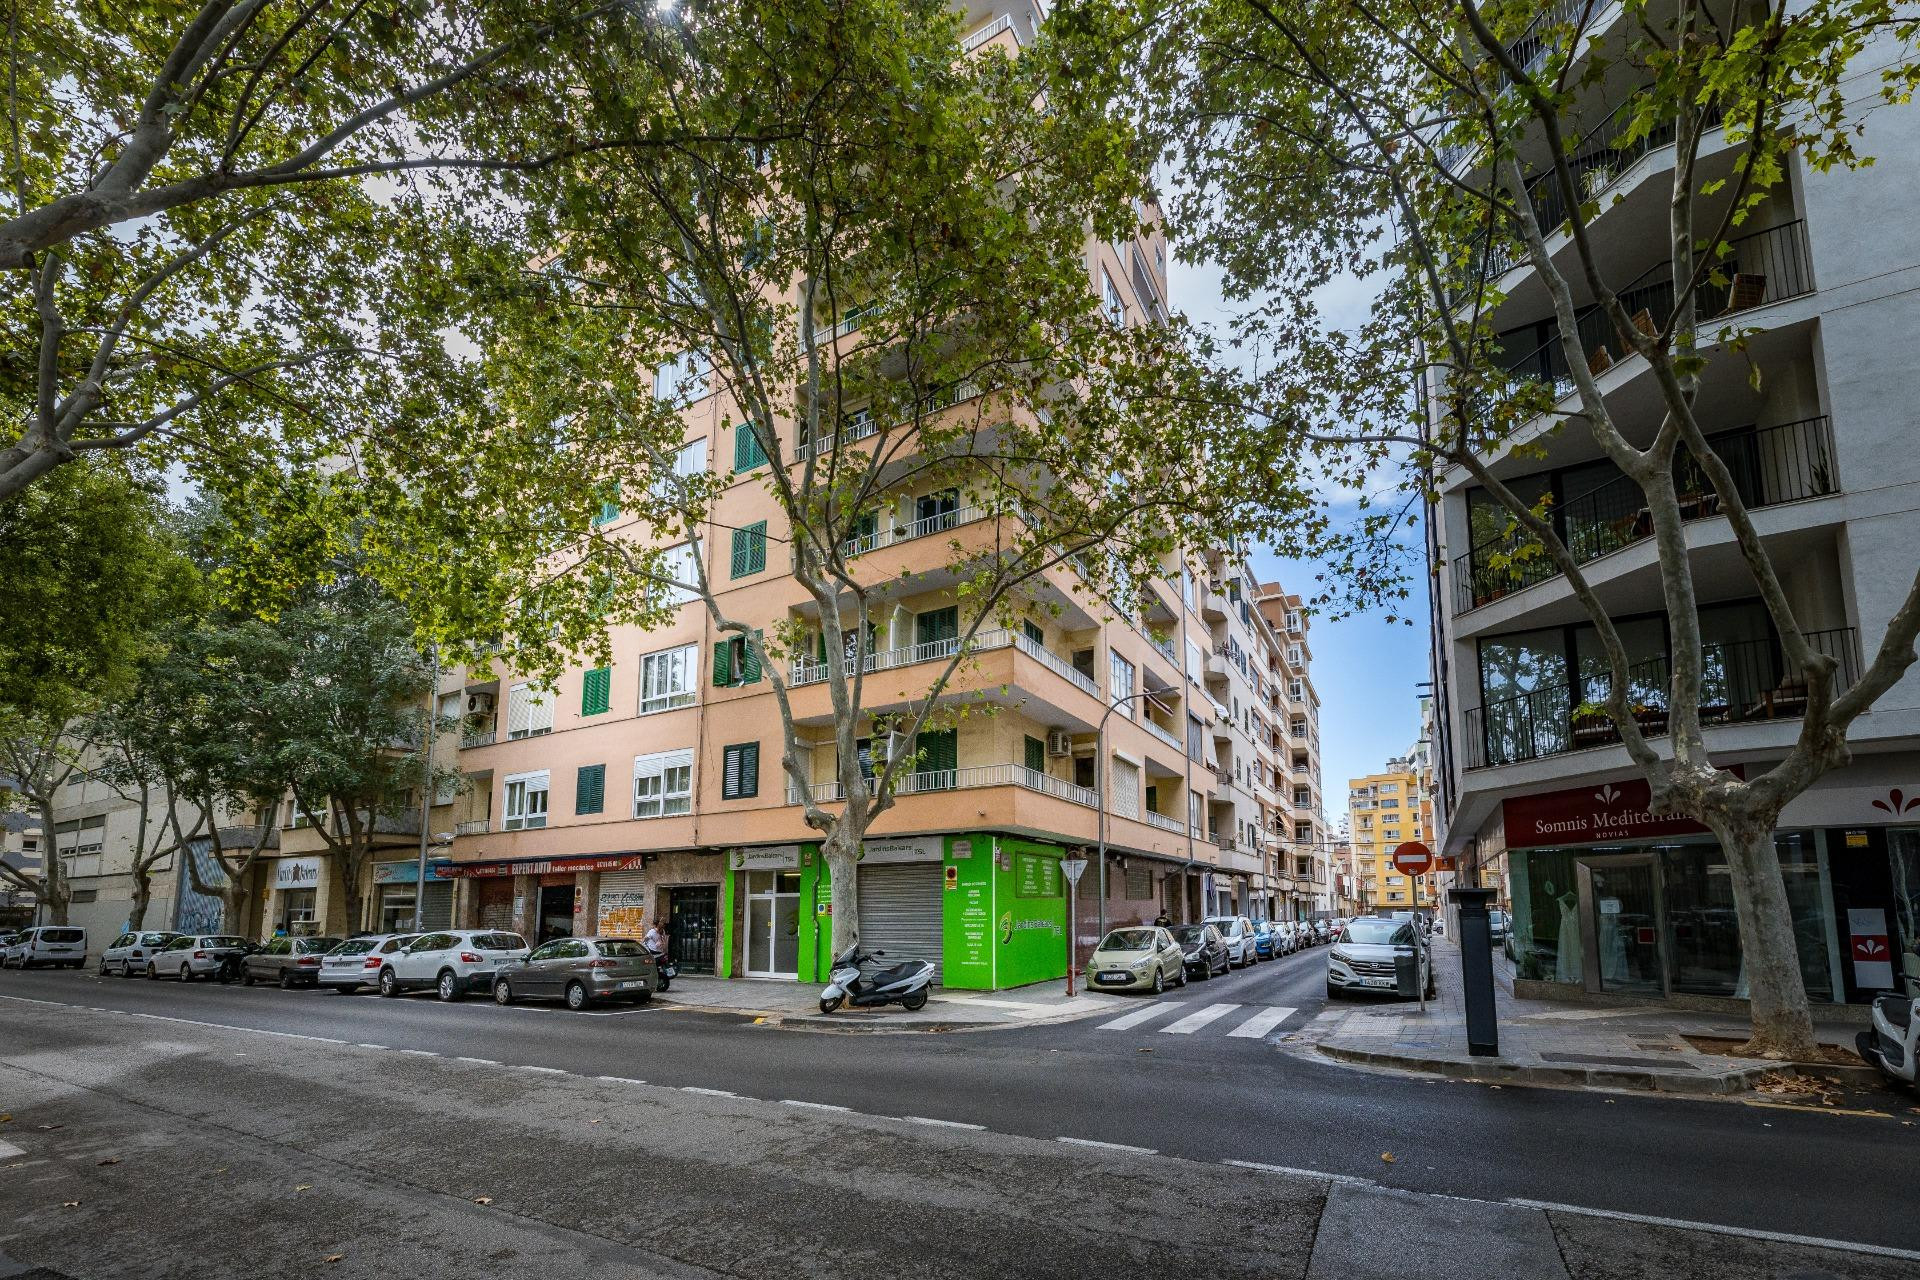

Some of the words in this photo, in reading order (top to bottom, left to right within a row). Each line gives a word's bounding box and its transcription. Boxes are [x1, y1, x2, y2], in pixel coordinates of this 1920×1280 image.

[1536, 816, 1588, 834] Somnis
[1595, 831, 1629, 839] NOVIAS
[511, 862, 534, 875] EXPERT
[534, 861, 552, 874] AUTO
